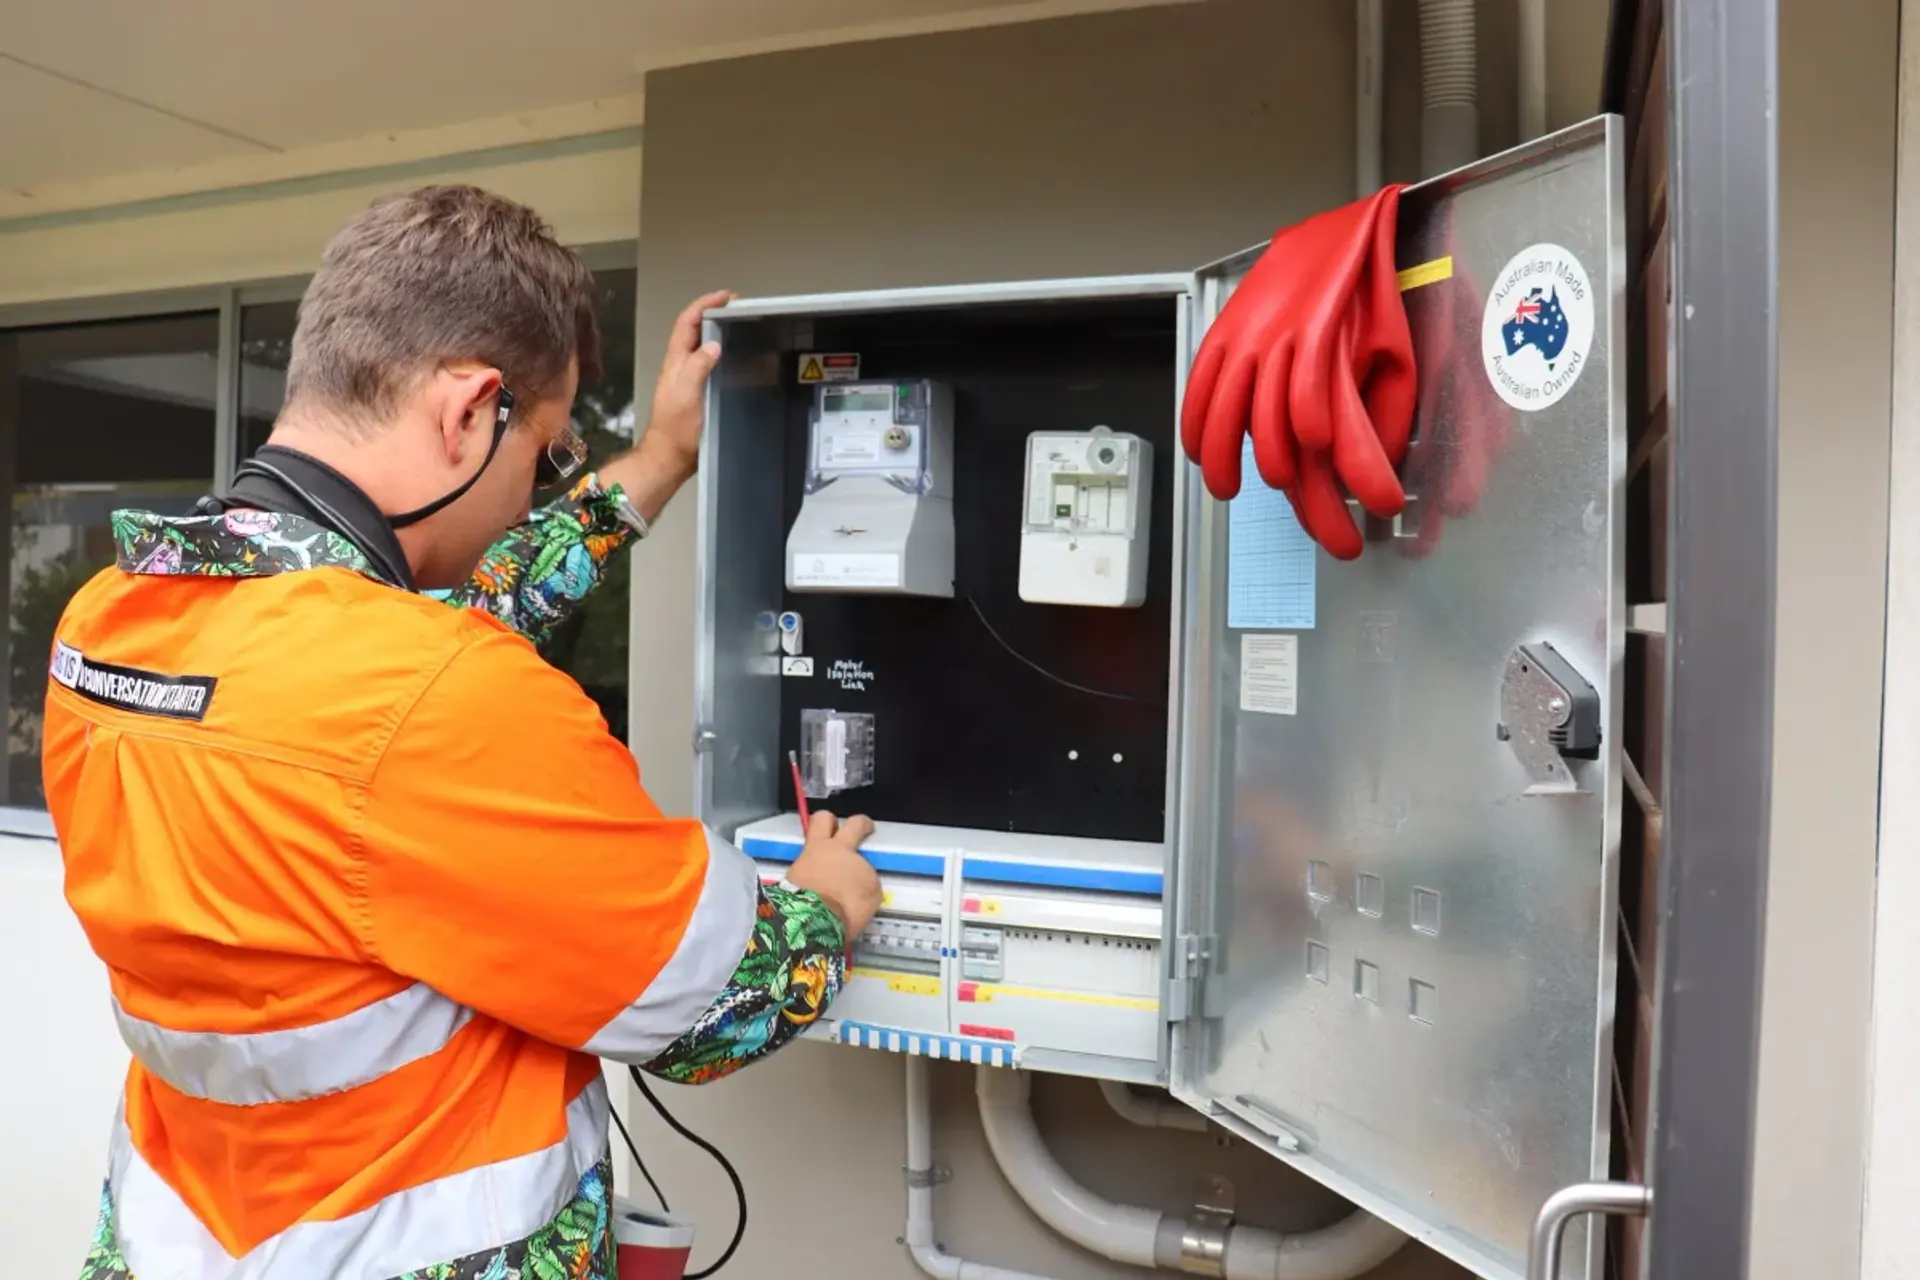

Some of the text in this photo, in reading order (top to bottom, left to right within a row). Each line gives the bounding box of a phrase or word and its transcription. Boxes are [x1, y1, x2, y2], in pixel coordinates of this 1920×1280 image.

[1494, 260, 1585, 306] Australian Made
[1493, 351, 1582, 399] Australian Owned
